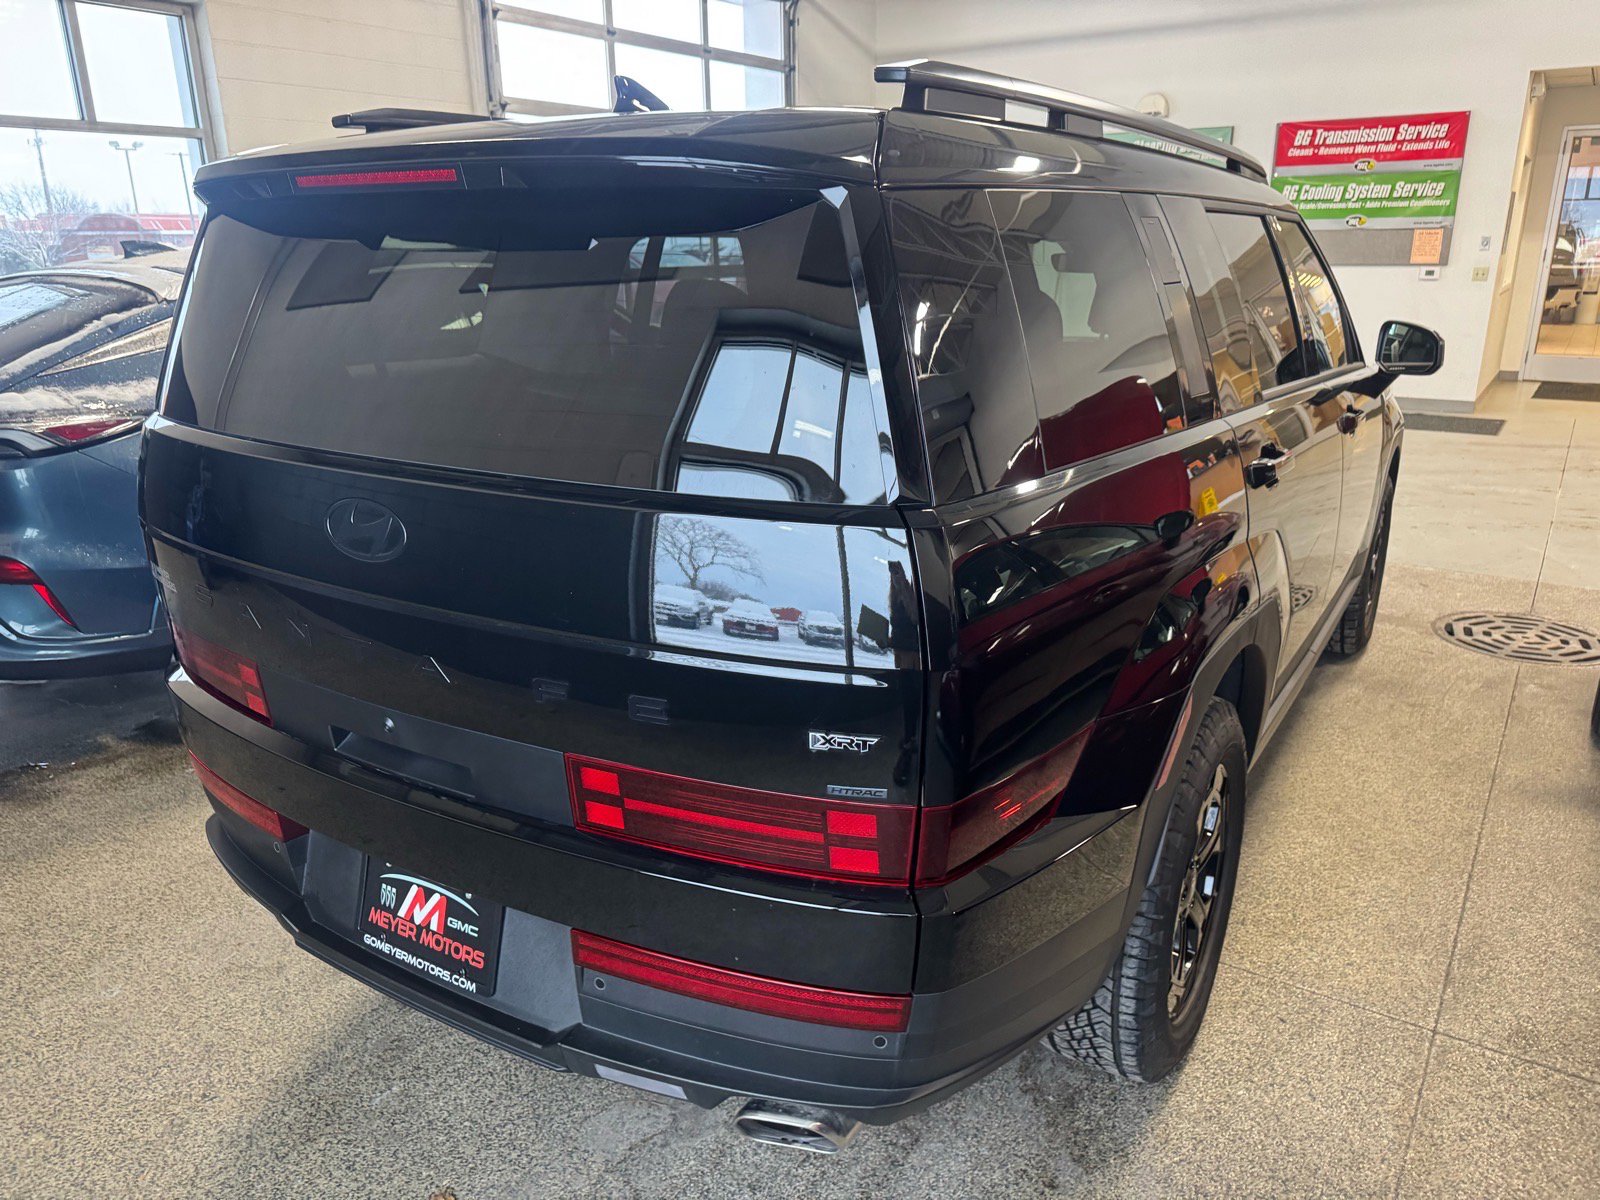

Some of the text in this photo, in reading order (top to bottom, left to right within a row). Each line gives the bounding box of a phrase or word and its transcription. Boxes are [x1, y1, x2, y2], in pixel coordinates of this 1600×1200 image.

[1294, 121, 1449, 148] BG Transmission Service
[1288, 140, 1450, 157] Cleans Removes Worn Fluid Extends Life
[1283, 180, 1446, 202] BG Cooling System Service
[1381, 199, 1409, 208] Premium
[1409, 198, 1451, 208] Conditioners
[809, 732, 881, 753] XRT
[831, 787, 885, 798] HTRAC
[368, 906, 485, 969] MEYER MOTORS
[447, 918, 479, 938] GMC
[363, 933, 477, 994] GOMEYERMOTORS.COM
